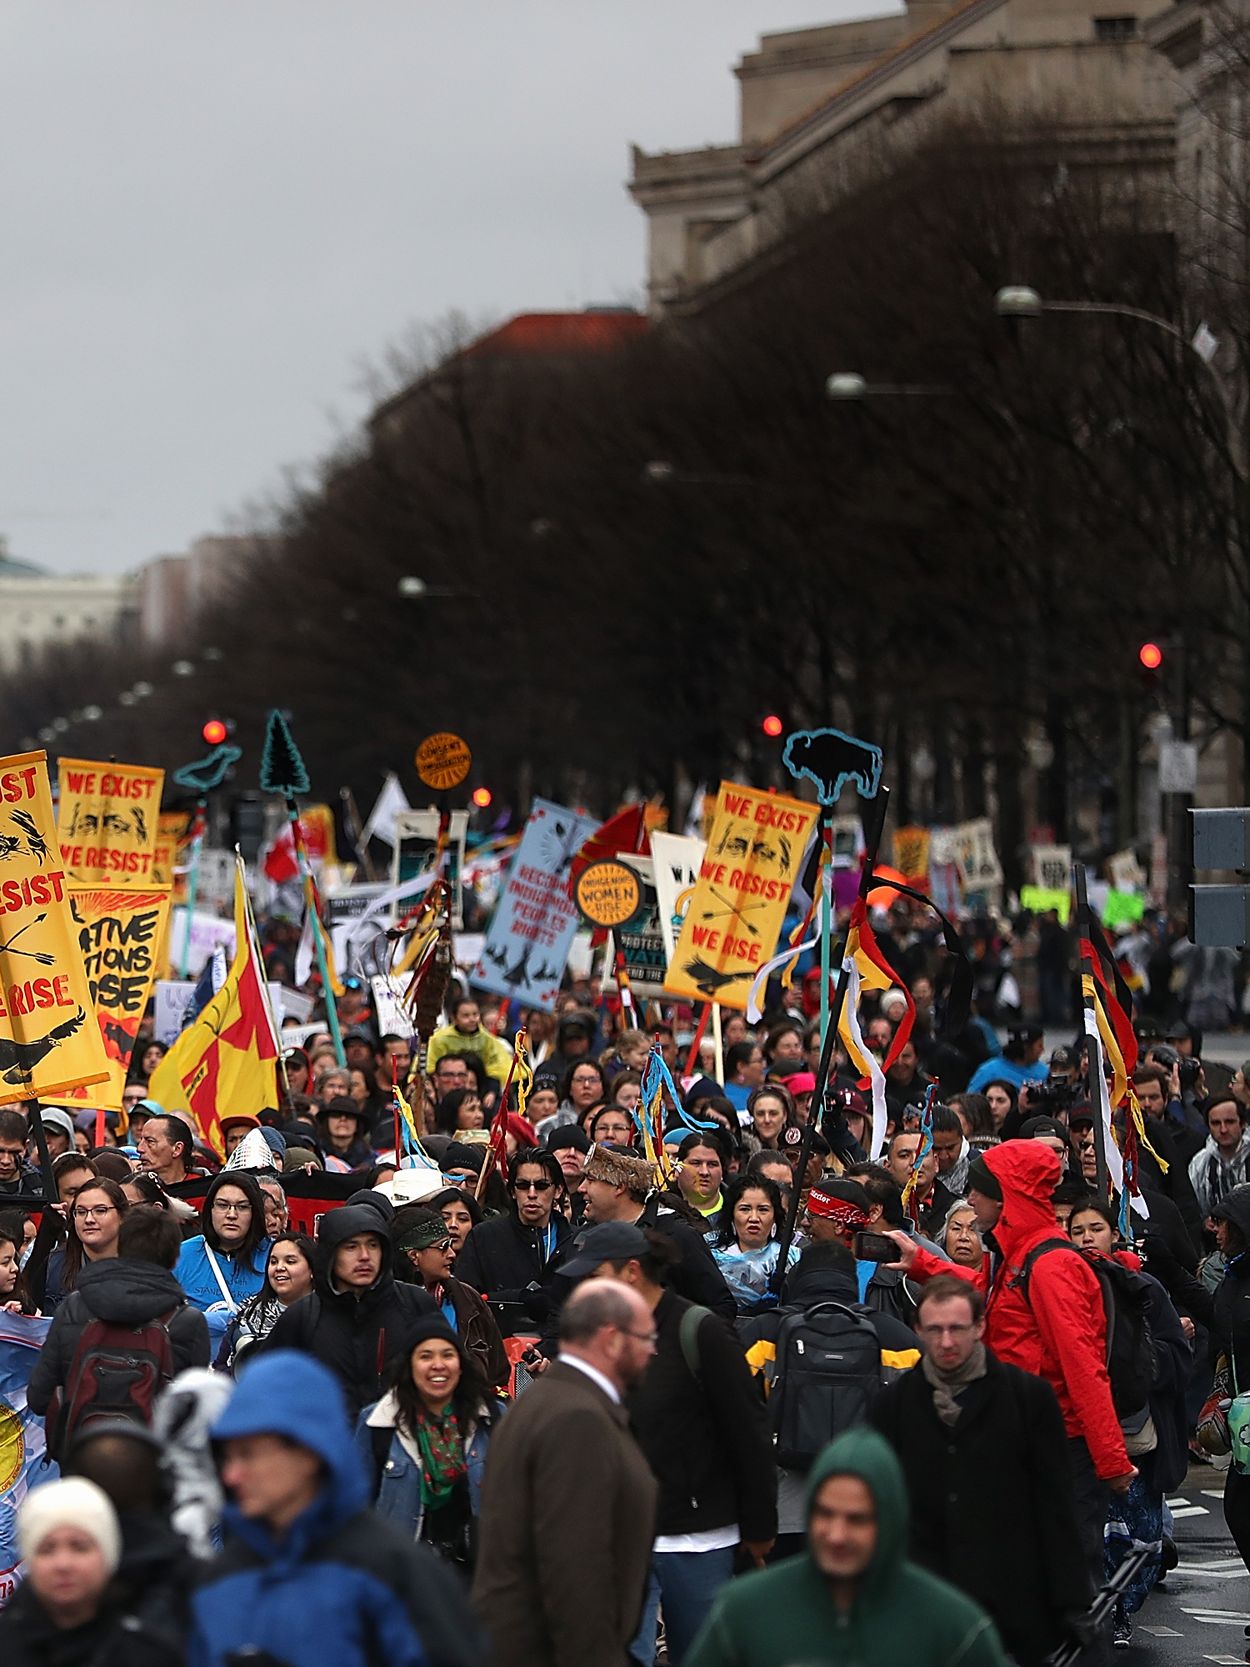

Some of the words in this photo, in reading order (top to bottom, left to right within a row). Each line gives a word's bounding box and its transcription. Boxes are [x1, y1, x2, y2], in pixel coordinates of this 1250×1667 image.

[67, 772, 96, 795] WE
[100, 773, 156, 799] EXIST
[723, 792, 753, 819] WE
[754, 803, 809, 835] EXIST
[85, 846, 152, 875] RESIST
[582, 887, 634, 902] WOMEN
[699, 859, 728, 885] WE
[729, 868, 791, 904] RESIST
[595, 900, 622, 912] RISE
[691, 925, 720, 951] WE
[721, 934, 762, 964] RISE
[8, 975, 74, 1017] RISE
